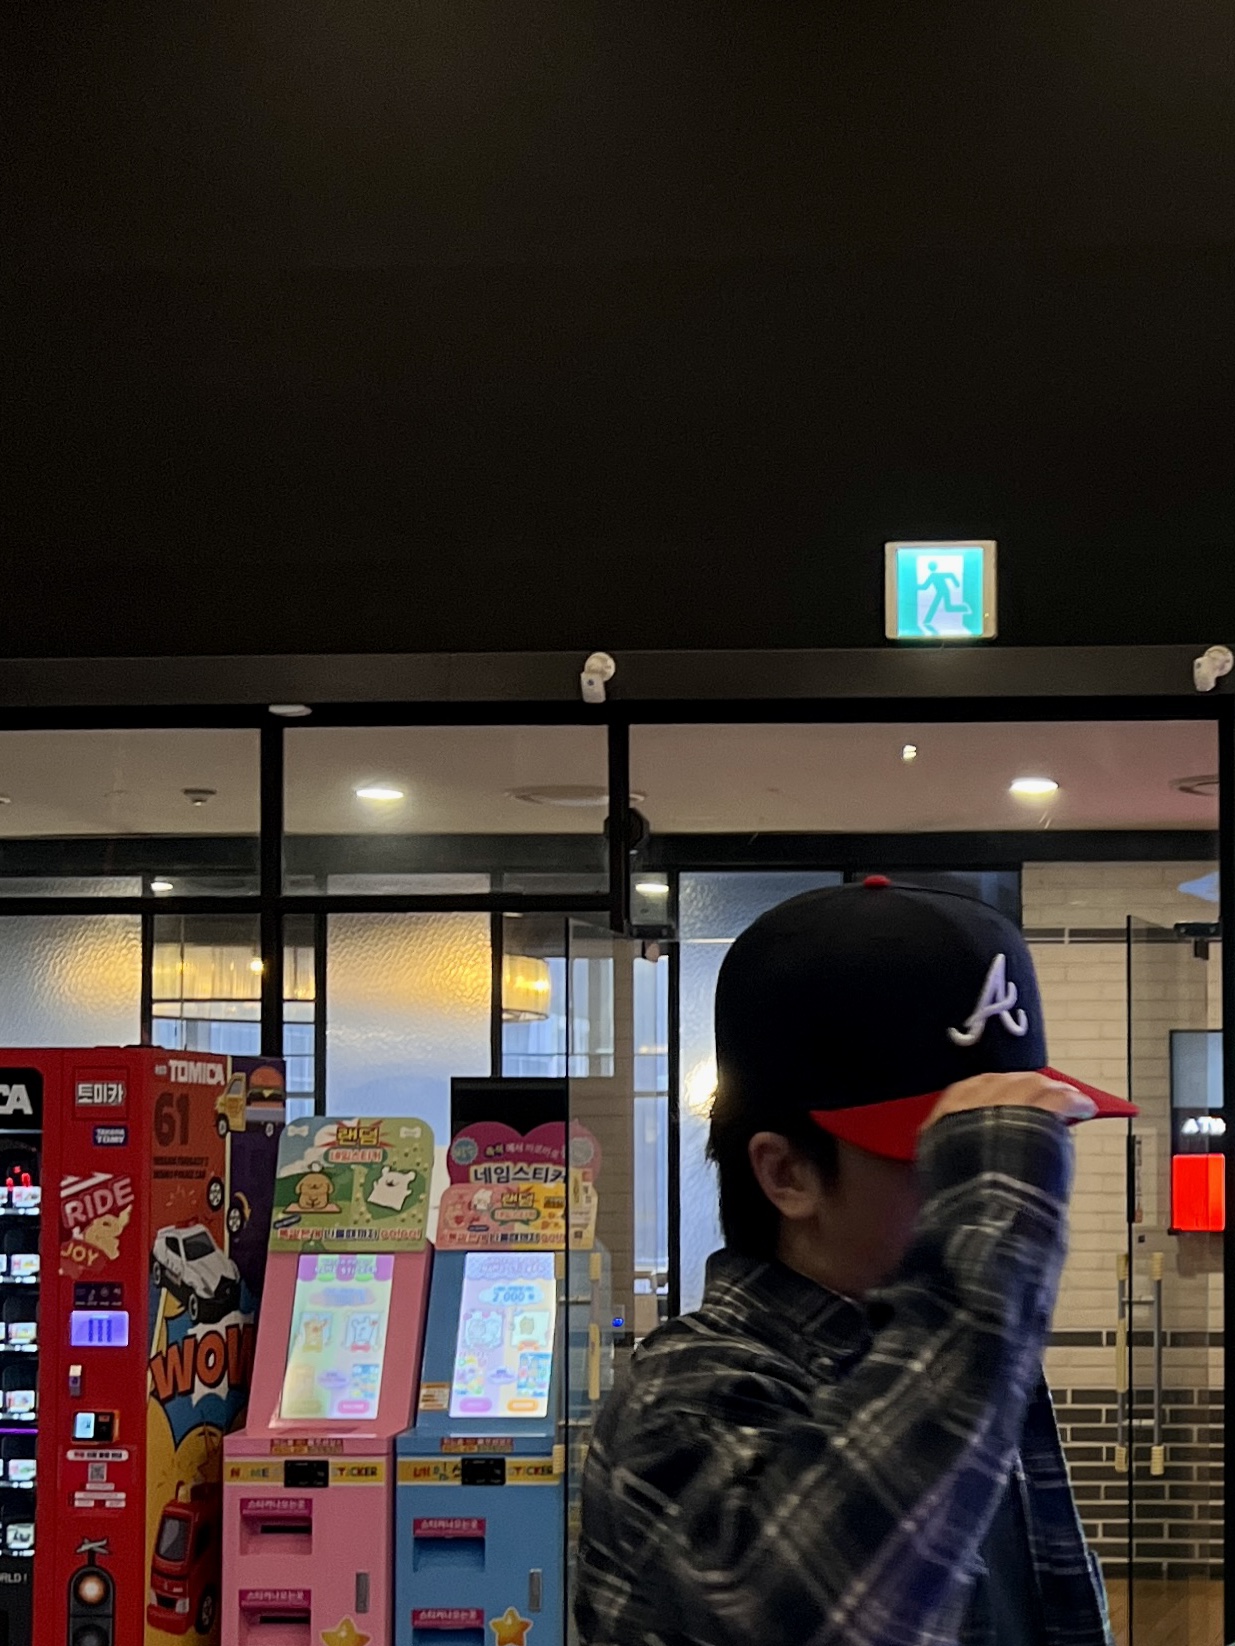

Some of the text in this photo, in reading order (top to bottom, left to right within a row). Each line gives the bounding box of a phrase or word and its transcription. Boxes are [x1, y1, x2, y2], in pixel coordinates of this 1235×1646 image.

[948, 953, 1028, 1046] A
[169, 1060, 225, 1085] TOMICA
[76, 1082, 125, 1104] 토미카
[154, 1091, 190, 1146] 61
[1181, 1115, 1227, 1136] ATM
[337, 1126, 380, 1147] 랜덤
[63, 1176, 135, 1228] RIDE
[61, 1243, 99, 1267] JOY
